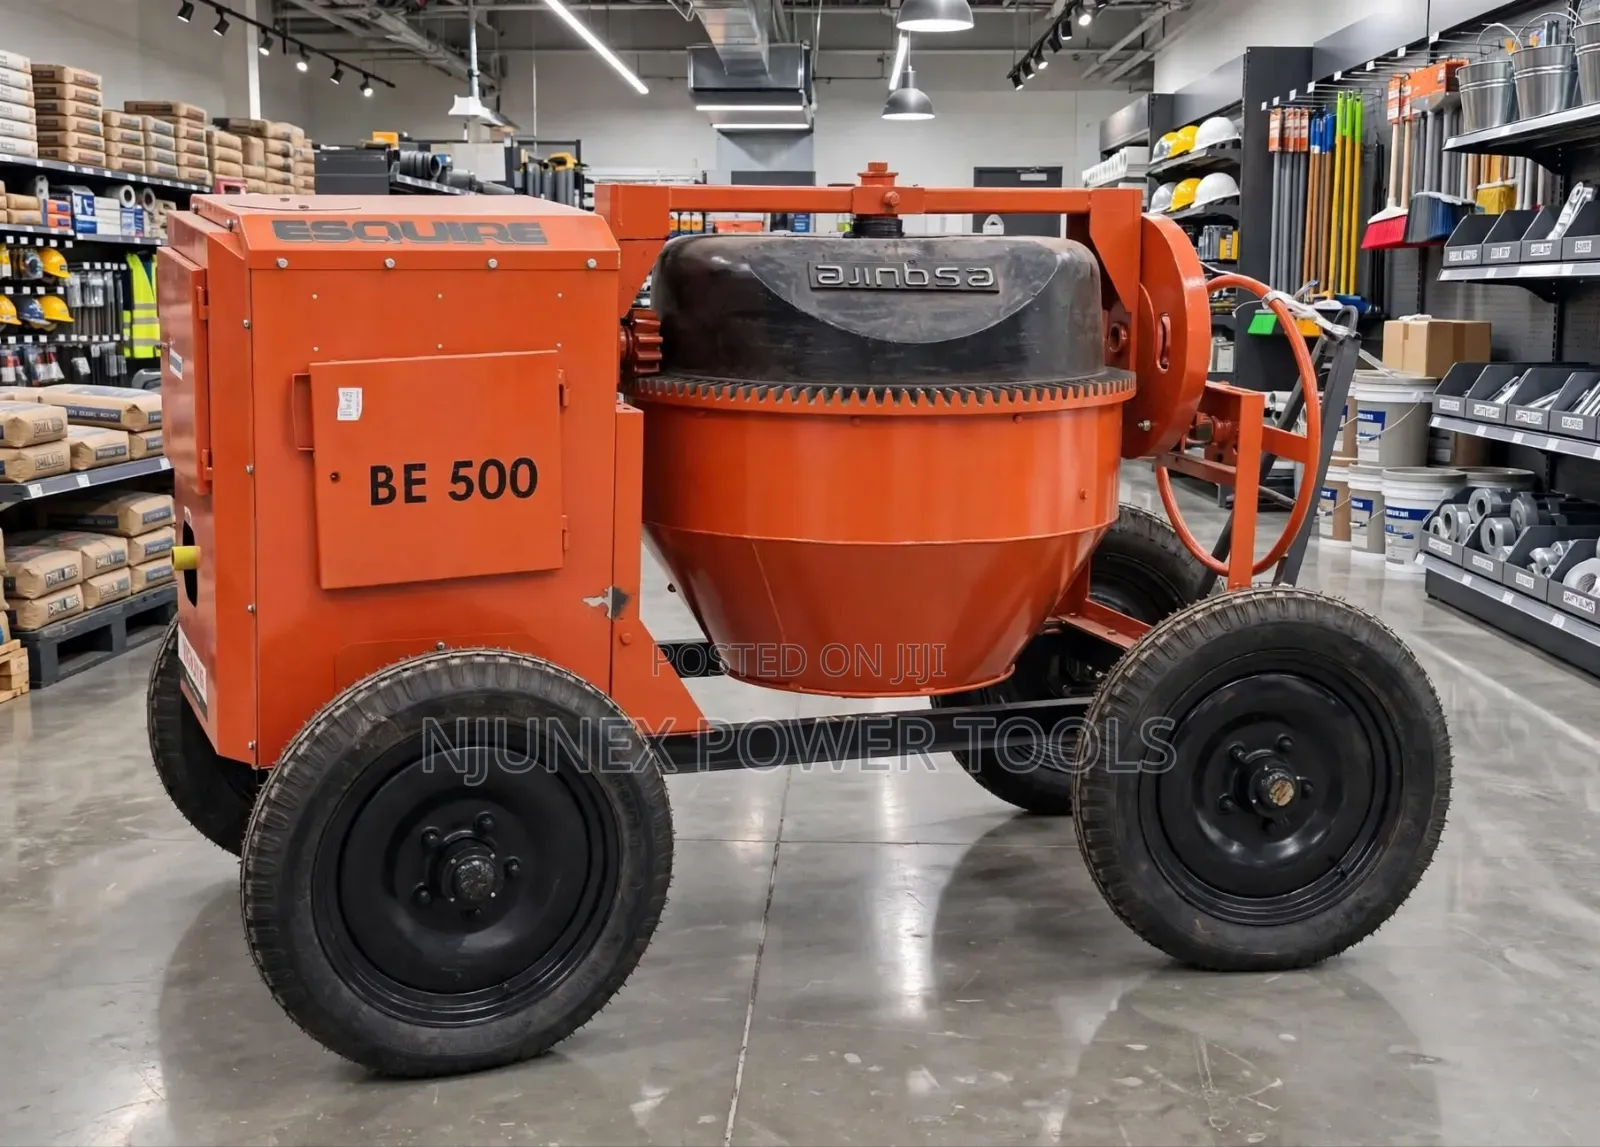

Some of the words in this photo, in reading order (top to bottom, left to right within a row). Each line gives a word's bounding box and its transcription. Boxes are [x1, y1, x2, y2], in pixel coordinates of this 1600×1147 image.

[271, 219, 549, 245] ESQUIRE
[369, 462, 427, 506] BE
[447, 457, 538, 502] 500
